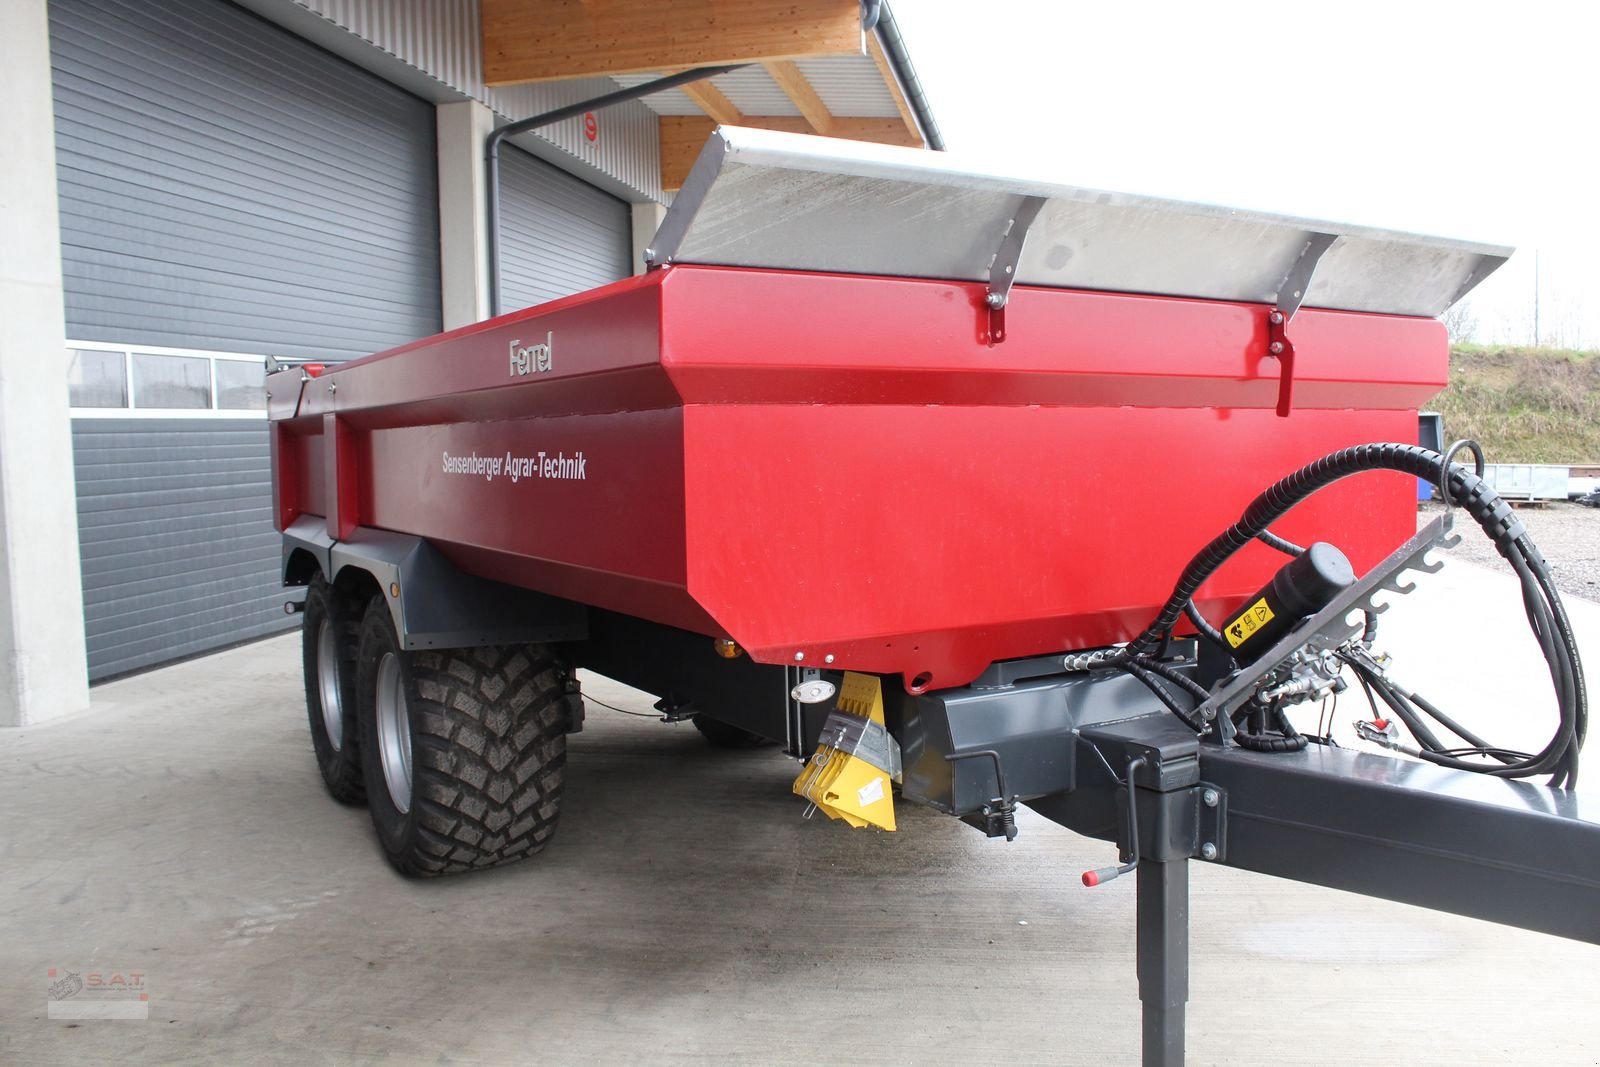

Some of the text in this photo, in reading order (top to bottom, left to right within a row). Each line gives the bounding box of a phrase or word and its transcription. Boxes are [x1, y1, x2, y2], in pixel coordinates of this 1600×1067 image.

[509, 331, 553, 377] Ferrel
[442, 451, 587, 483] Sensenberger Agrar-Technik
